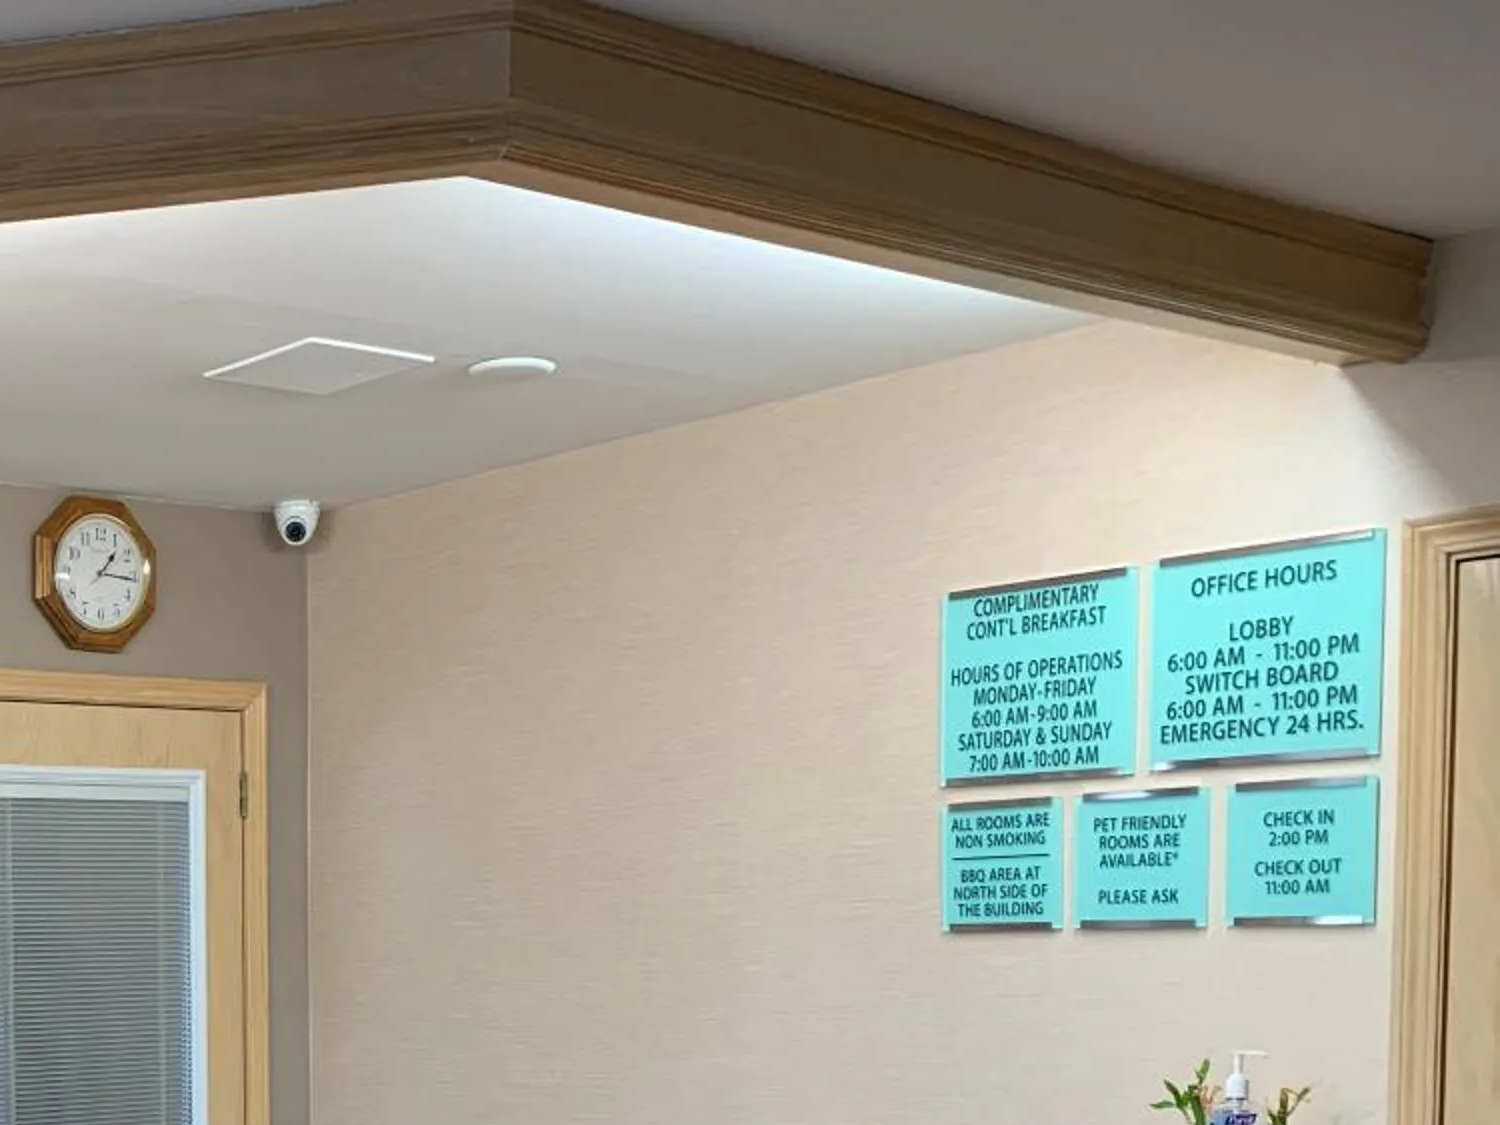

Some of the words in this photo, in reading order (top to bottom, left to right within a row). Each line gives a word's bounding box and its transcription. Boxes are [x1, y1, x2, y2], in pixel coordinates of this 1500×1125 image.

[1191, 570, 1258, 598] OFFICE
[1265, 560, 1337, 589] HOURS
[974, 584, 1099, 617] COMPLIMENTARY
[967, 617, 1017, 640] CONT'L
[1022, 606, 1107, 634] BREAKFAST
[1229, 616, 1295, 642] LOBBY
[1167, 651, 1207, 673] 6:00
[1213, 646, 1245, 669] AM
[1274, 639, 1320, 661] 11:00
[1328, 633, 1360, 656] PM
[951, 664, 999, 687] HOURS
[1004, 661, 1023, 681] OF
[1028, 650, 1122, 678] OPERATIONS
[1185, 669, 1259, 695] SWITCH
[1266, 661, 1339, 687] BOARD
[972, 709, 1000, 728] 6:00
[1073, 700, 1097, 719] AM
[1166, 699, 1206, 721] 6:00
[1212, 695, 1244, 717] AM
[1272, 688, 1320, 711] 11:00
[1326, 684, 1358, 706] PM
[958, 728, 1031, 751] SATURDAY
[1036, 727, 1047, 745] &
[1051, 720, 1112, 744] SUNDAY
[1160, 715, 1280, 745] EMERGENCY
[1286, 714, 1309, 735] 24
[1317, 709, 1364, 733] HRS.
[969, 754, 998, 772] 7:00
[1075, 745, 1099, 765] AM
[951, 817, 973, 832] ALL
[976, 814, 1022, 830] ROOMS
[1026, 812, 1050, 827] ARE
[1093, 817, 1117, 833] PET
[1121, 813, 1187, 831] FRIENDLY
[1263, 809, 1313, 828] CHECK
[1318, 808, 1335, 825] IN
[955, 834, 983, 848] NON
[987, 830, 1046, 848] SMOKING
[1099, 833, 1149, 850] ROOMS
[1153, 833, 1180, 848] ARE
[1269, 831, 1301, 847] 2:00
[1305, 829, 1329, 845] PM
[961, 868, 985, 883] BBQ
[989, 867, 1021, 881] AREA
[1026, 865, 1041, 880] AT
[1254, 859, 1304, 877] CHECK
[1308, 857, 1342, 875] OUT
[953, 885, 997, 901] NORTH
[1000, 884, 1027, 899] SIDE
[1031, 883, 1048, 898] OF
[1098, 889, 1147, 905] PLEASE
[1151, 888, 1179, 905] ASK
[1265, 879, 1301, 895] 11:00
[1305, 878, 1330, 894] AM
[958, 903, 981, 917] THE
[984, 901, 1044, 917] BUILDING
